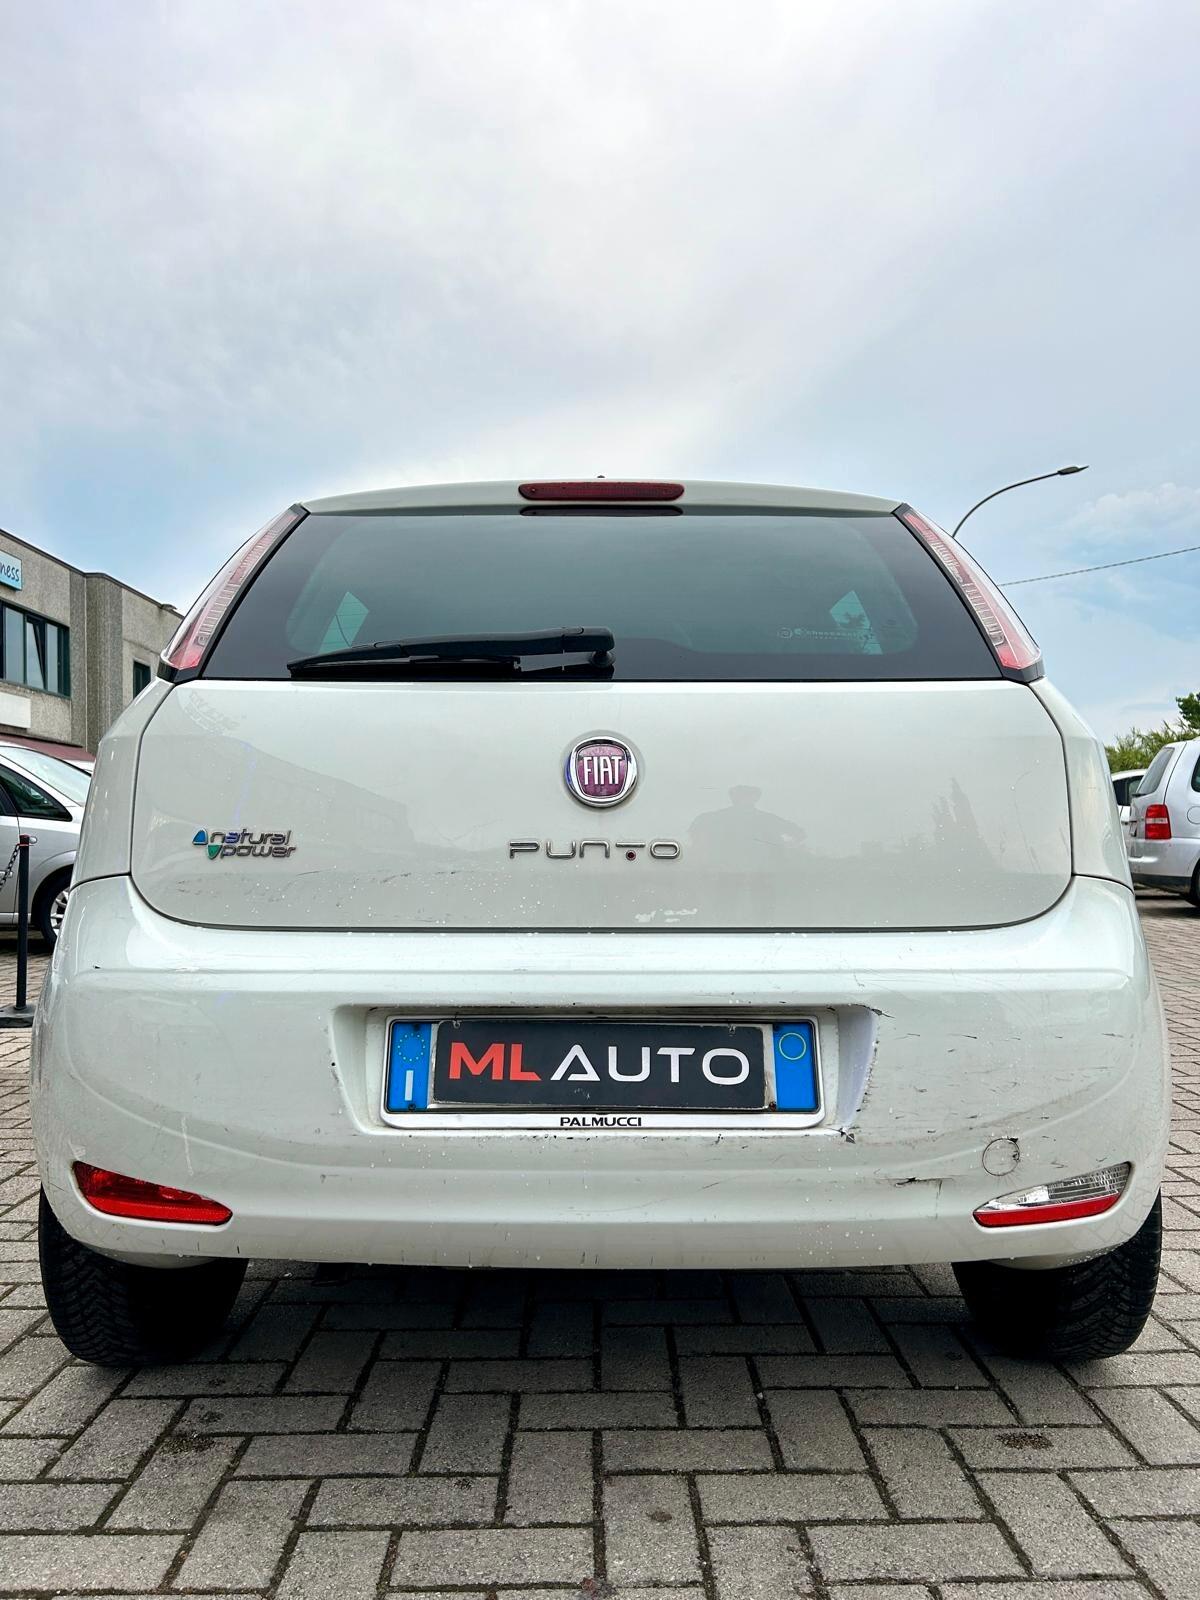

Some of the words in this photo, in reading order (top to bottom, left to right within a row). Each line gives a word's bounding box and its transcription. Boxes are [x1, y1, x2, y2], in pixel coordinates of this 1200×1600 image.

[583, 755, 622, 785] FIAT
[210, 828, 292, 845] natural
[220, 844, 296, 859] power
[509, 840, 681, 860] PUNTO
[449, 1042, 542, 1081] ML
[550, 1044, 750, 1085] AUTO
[405, 1070, 414, 1101] I
[560, 1117, 642, 1127] PALMUCCI
